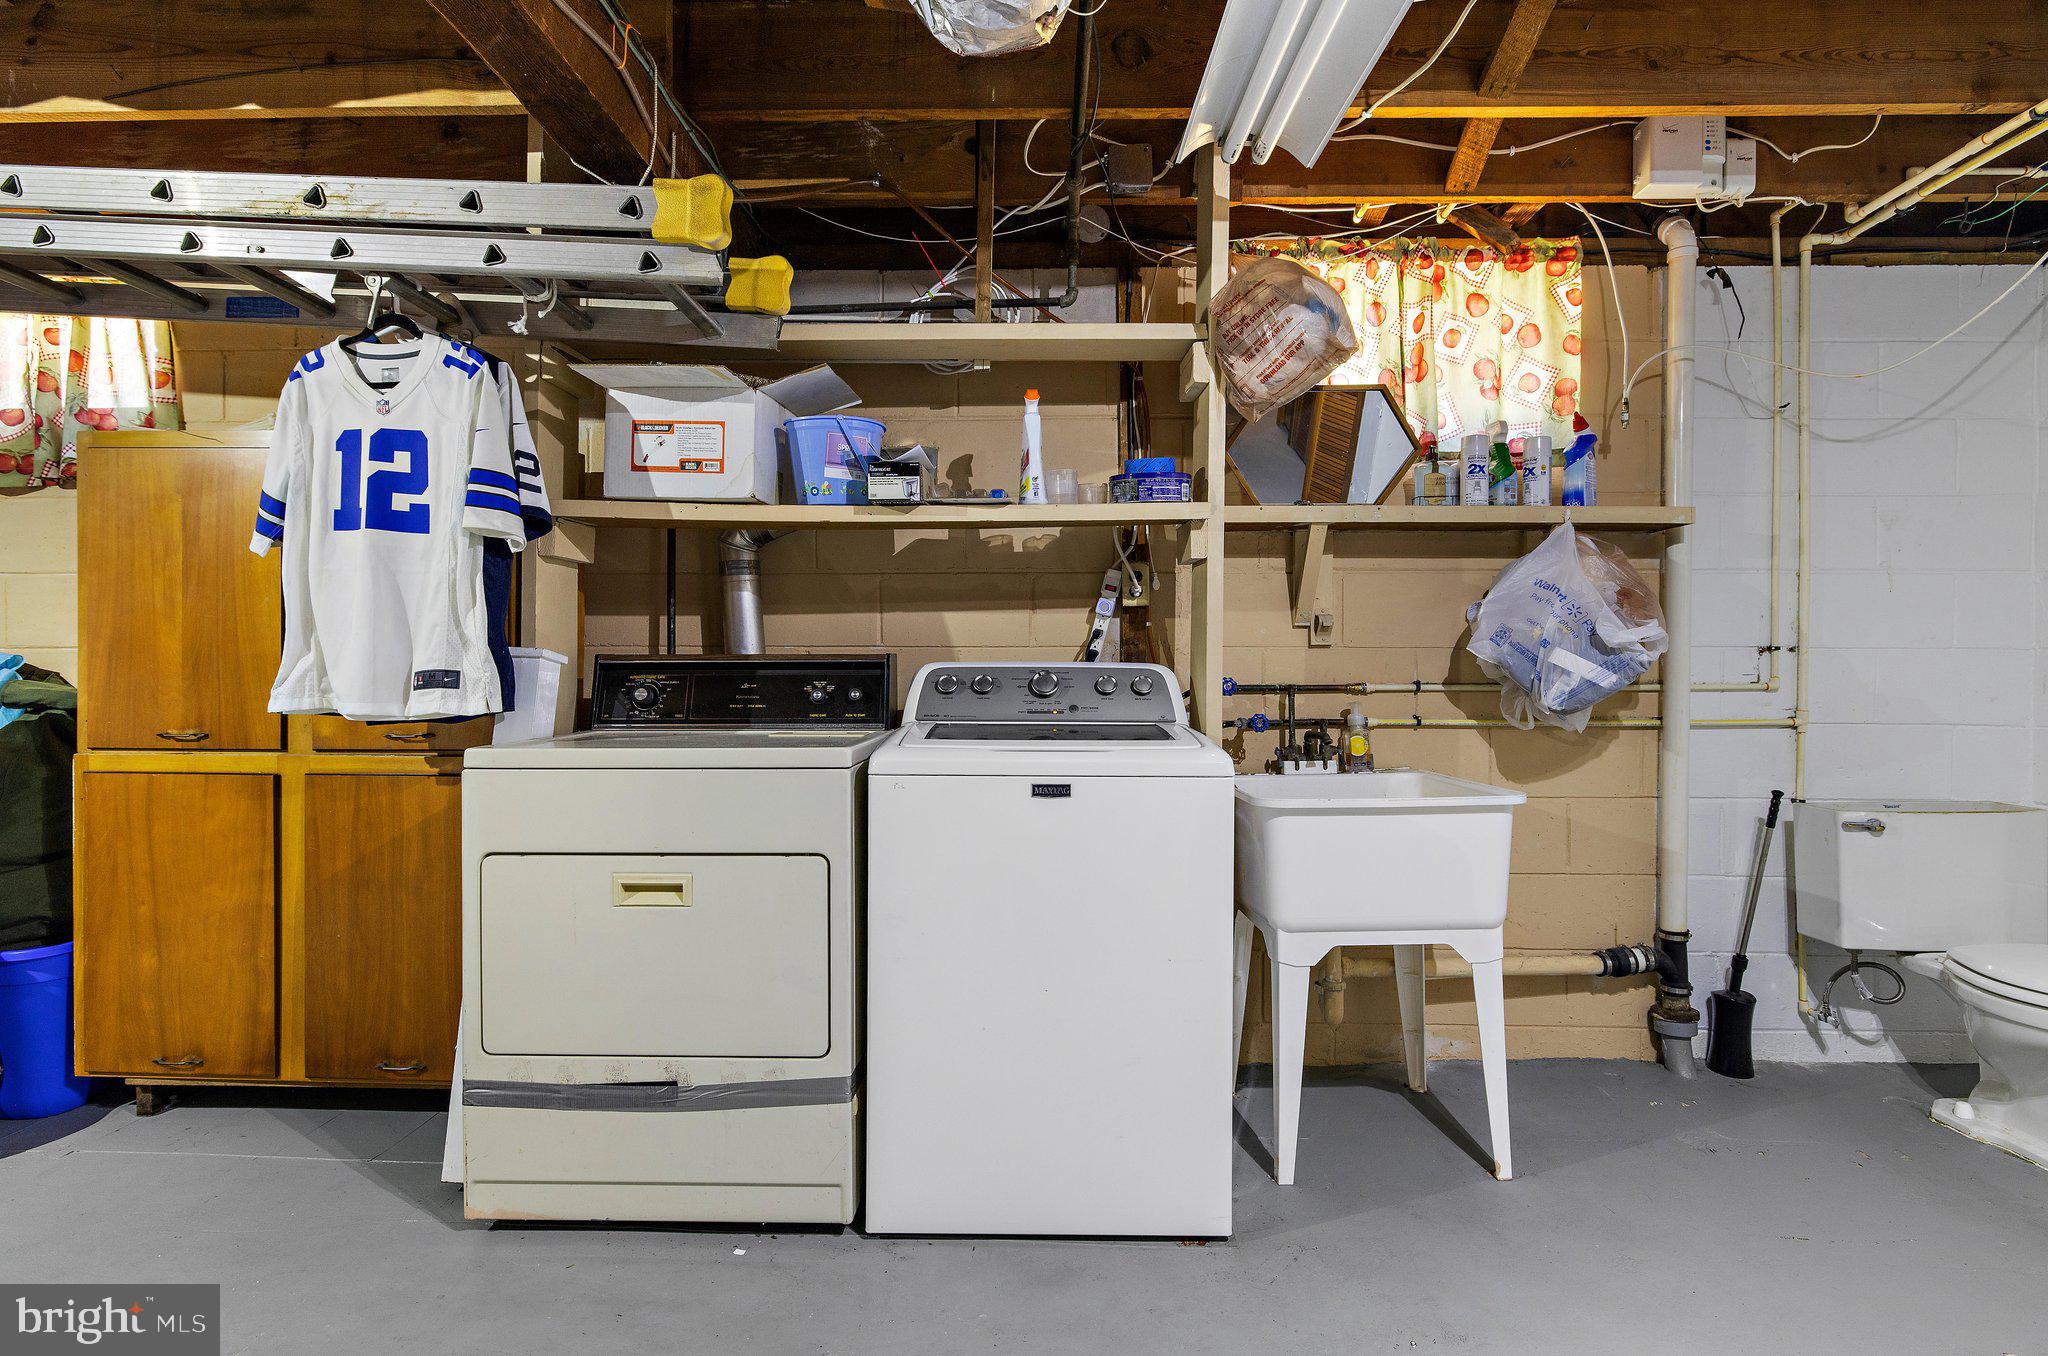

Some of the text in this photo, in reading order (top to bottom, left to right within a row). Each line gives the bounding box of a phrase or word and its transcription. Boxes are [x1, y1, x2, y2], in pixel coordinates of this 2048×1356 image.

[1226, 297, 1279, 345] PICK UP IN STORE FREE
[1222, 329, 1231, 340] BUY
[1241, 351, 1256, 364] TOOL
[1260, 339, 1306, 384] DOWNLOAD OUR APP
[1468, 463, 1487, 475] 2X
[333, 427, 430, 535] 12
[1530, 593, 1544, 604] Pay
[1558, 618, 1578, 639] phone
[1582, 618, 1600, 636] Pay
[1034, 786, 1070, 795] MAYTAG
